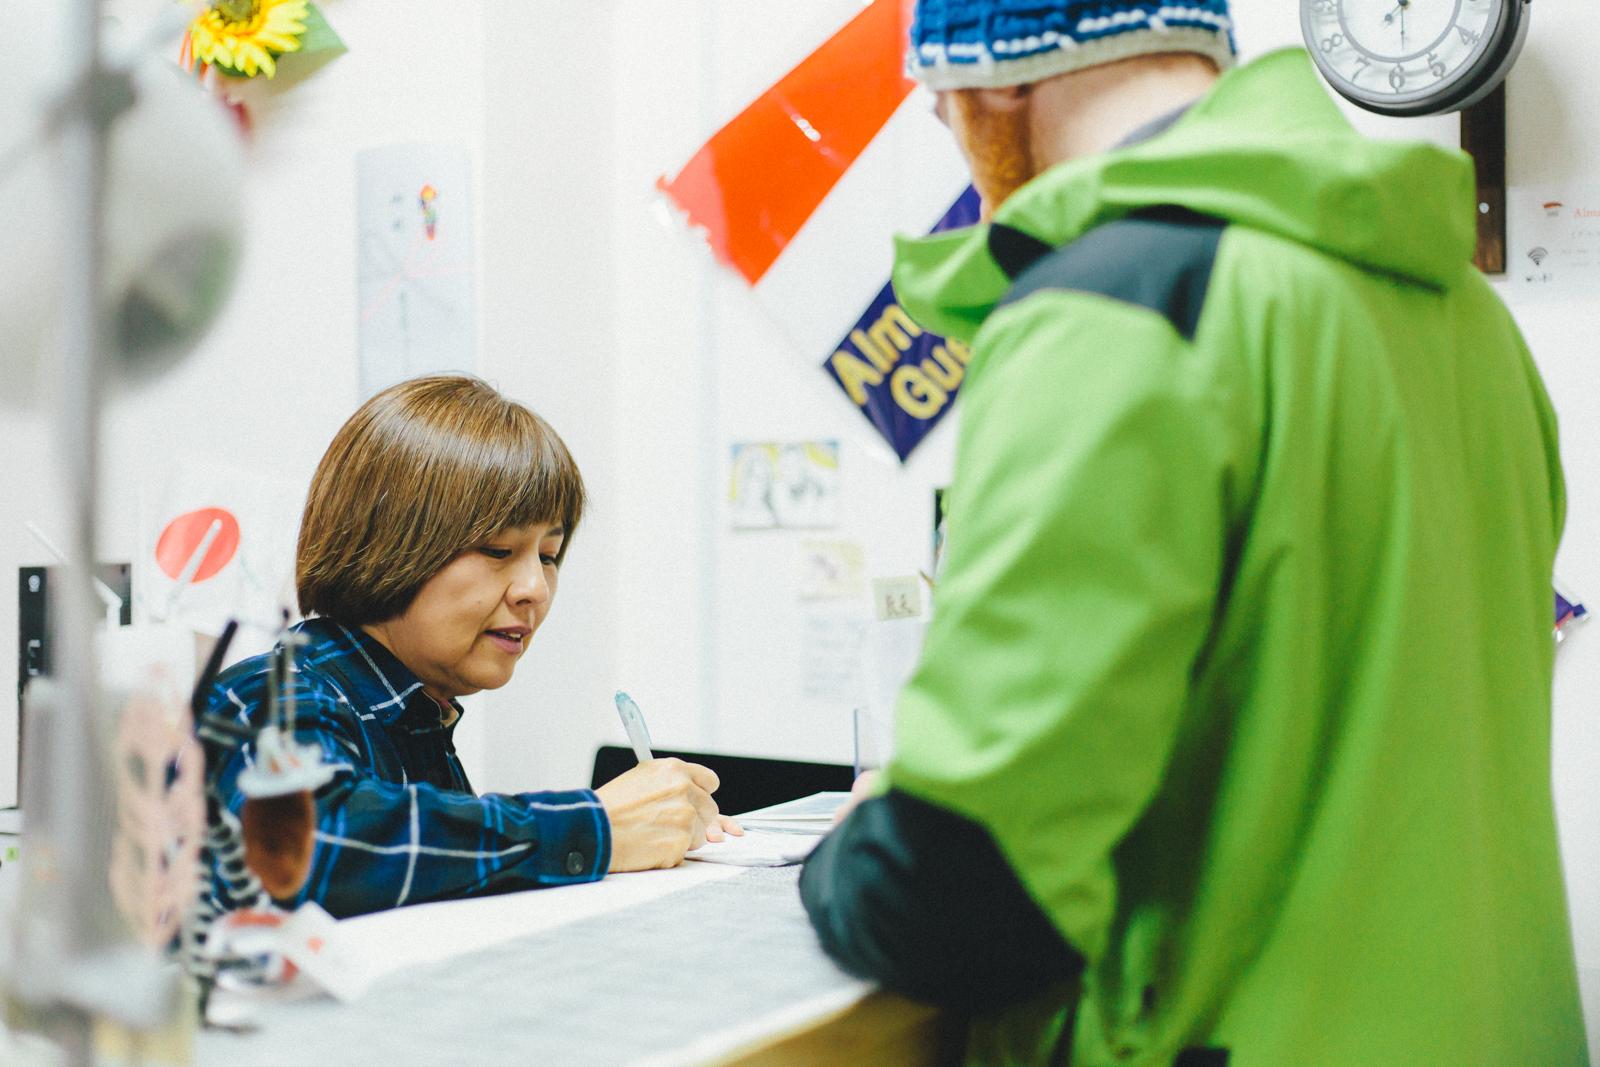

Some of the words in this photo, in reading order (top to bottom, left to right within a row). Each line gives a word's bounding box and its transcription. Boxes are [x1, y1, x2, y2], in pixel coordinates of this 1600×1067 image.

[1321, 33, 1343, 53] 8
[1454, 24, 1481, 45] 4
[1351, 56, 1371, 83] 7
[1388, 61, 1406, 94] 6
[1426, 51, 1447, 79] 5
[831, 304, 921, 406] Alm
